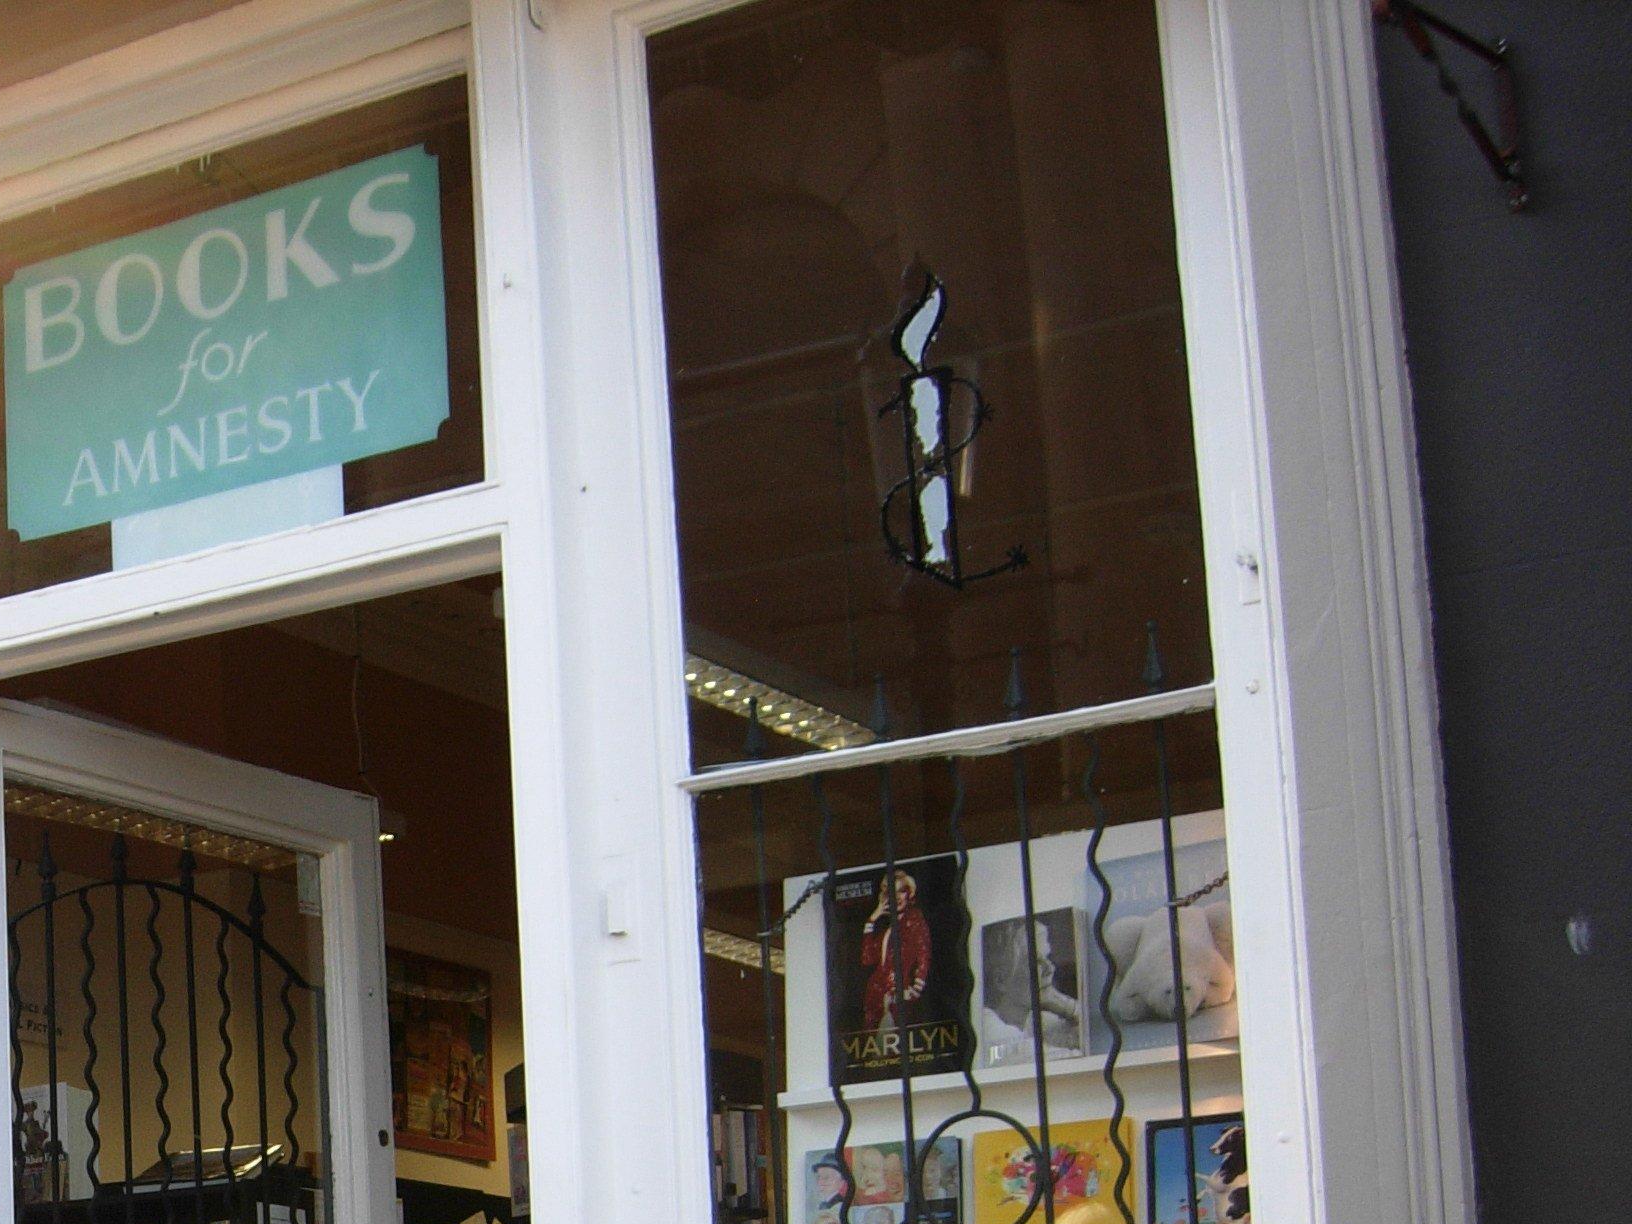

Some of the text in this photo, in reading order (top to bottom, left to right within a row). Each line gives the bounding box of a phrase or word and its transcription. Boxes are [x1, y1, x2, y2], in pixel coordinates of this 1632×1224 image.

[25, 172, 416, 375] BOOKS
[158, 326, 268, 417] for
[62, 368, 381, 506] AMNESTY
[843, 1024, 959, 1060] MARLYN
